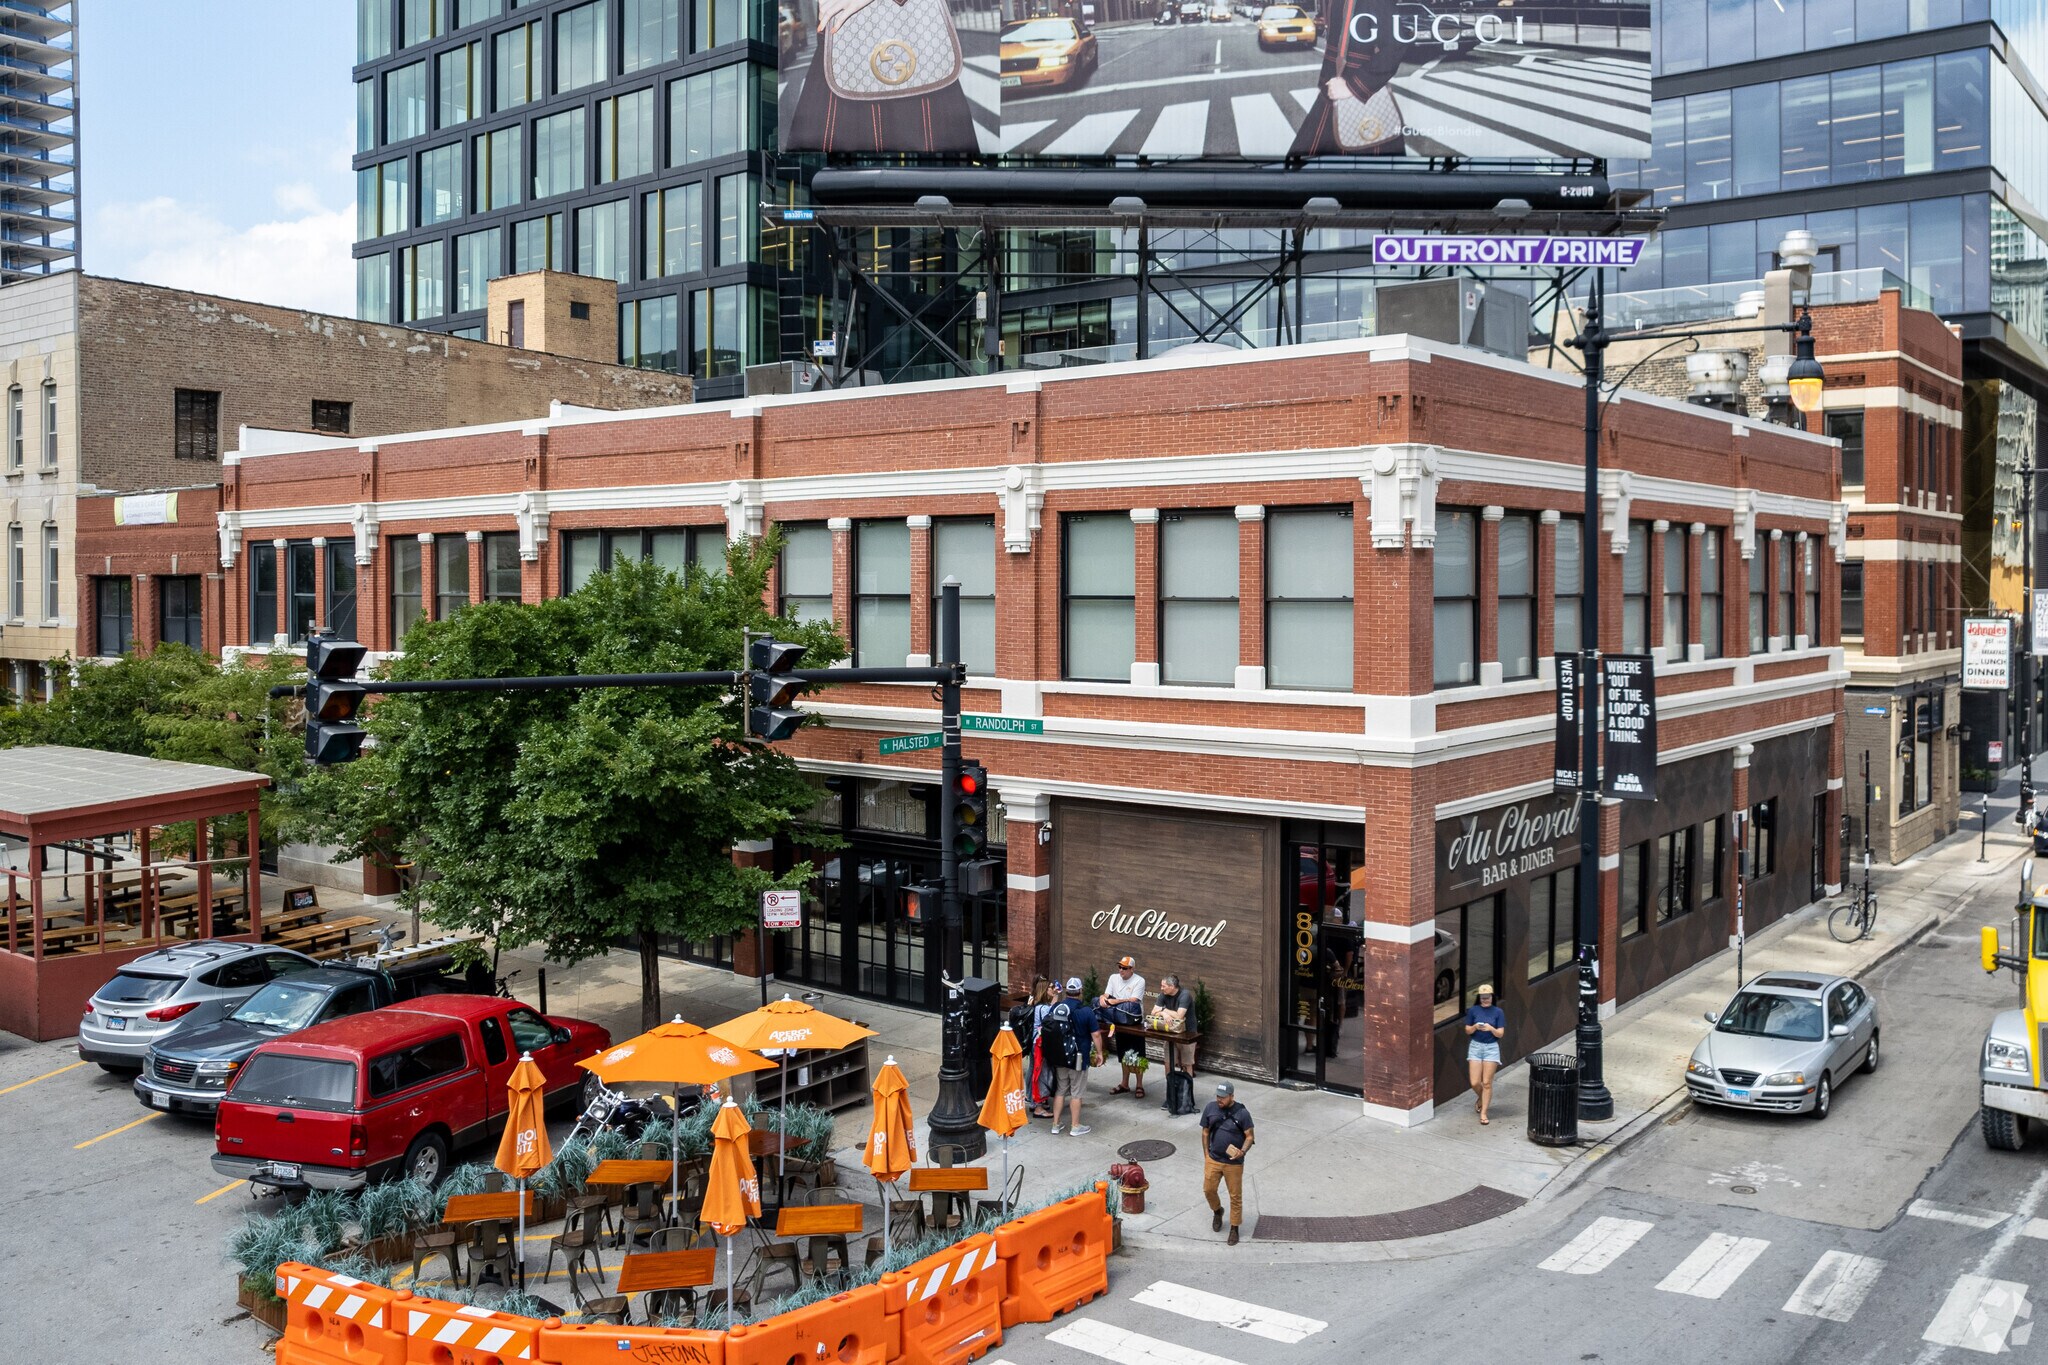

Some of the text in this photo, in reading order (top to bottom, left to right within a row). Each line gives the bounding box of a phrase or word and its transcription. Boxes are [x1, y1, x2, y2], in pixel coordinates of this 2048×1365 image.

[1350, 13, 1524, 45] GUCCI
[1393, 125, 1483, 137] #GucciBlondie
[1606, 661, 1642, 674] WHERE
[1967, 668, 2005, 676] DINNER
[1607, 675, 1630, 687] 'OUT
[1561, 659, 1574, 721] WEST LOOP
[1608, 688, 1643, 702] OF THE
[1608, 702, 1650, 716] LOOP' IS
[975, 717, 1026, 731] RANDOLPH
[1608, 716, 1645, 729] A GOOD
[892, 736, 930, 751] HALSTED
[1608, 730, 1642, 743] THING.
[1613, 782, 1644, 792] BRAVA
[1448, 796, 1582, 871] Au Cheval
[1482, 846, 1555, 886] BAR & DINER
[1091, 904, 1227, 947] Au Cheval
[1296, 912, 1313, 965] 800
[769, 1028, 813, 1040] APEROL
[776, 1035, 807, 1043] SPRITZ
